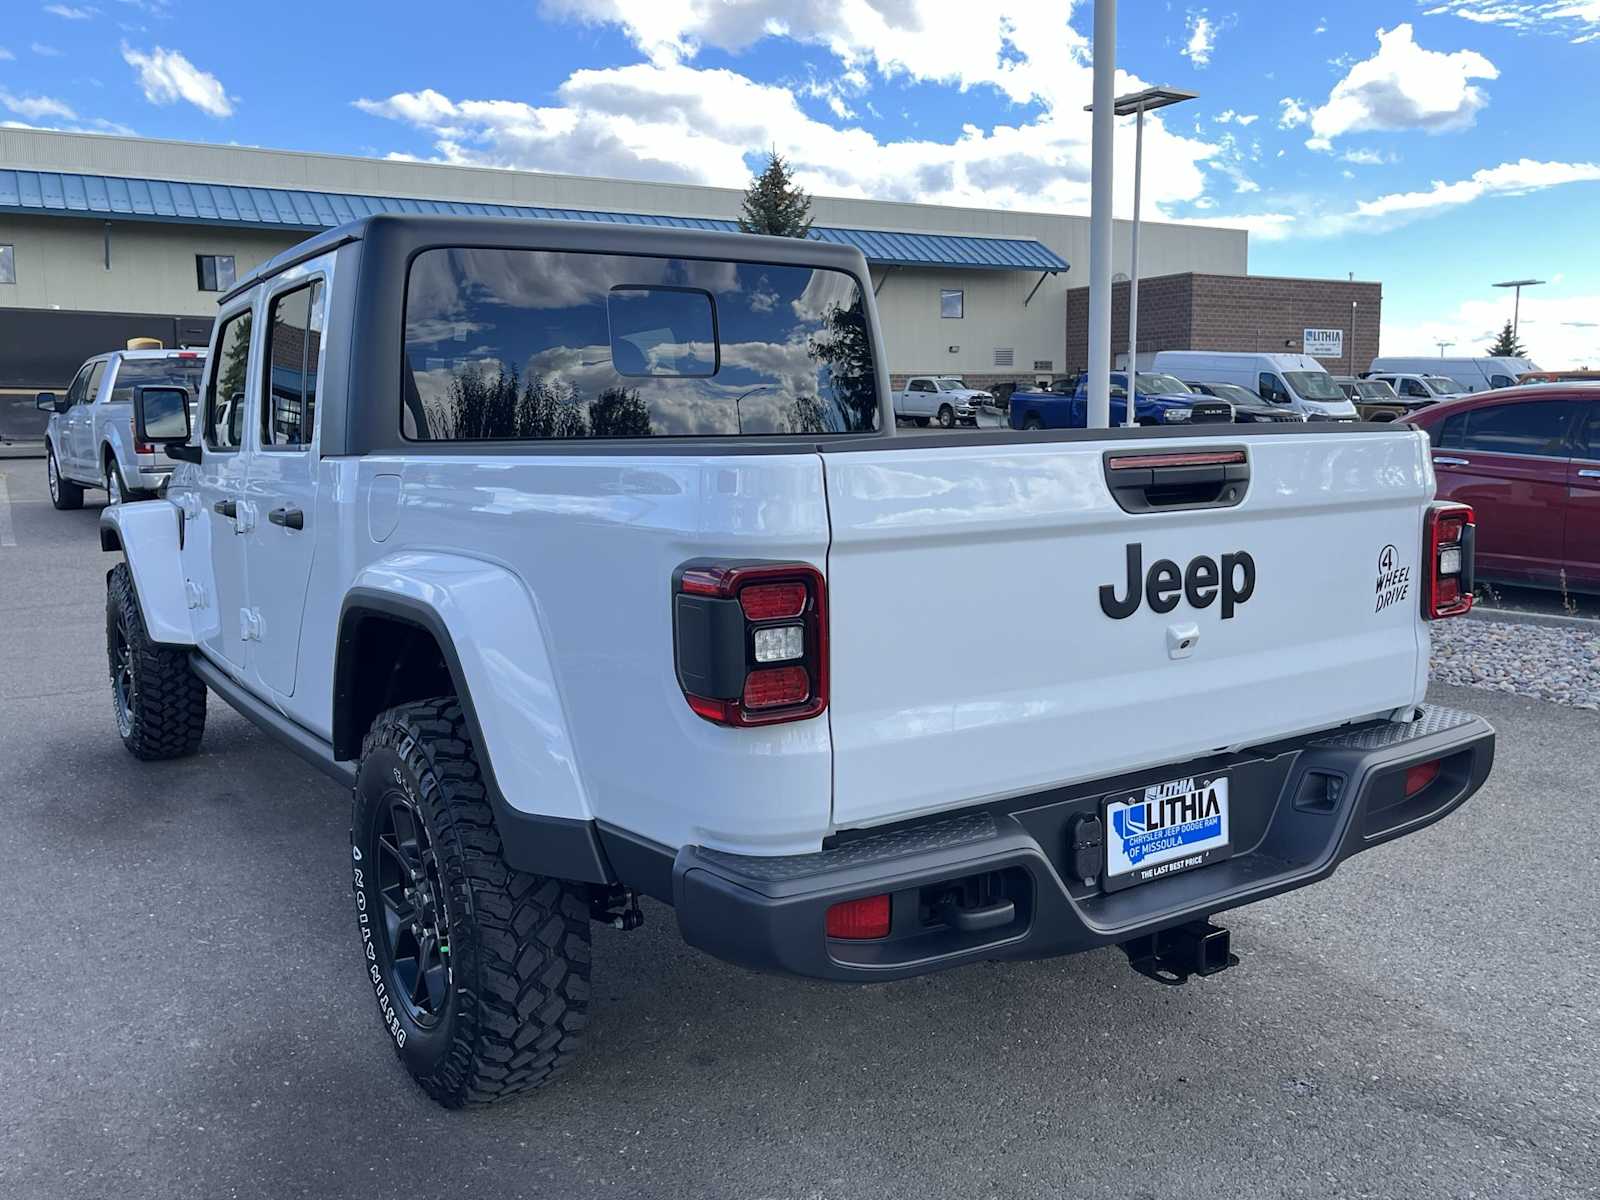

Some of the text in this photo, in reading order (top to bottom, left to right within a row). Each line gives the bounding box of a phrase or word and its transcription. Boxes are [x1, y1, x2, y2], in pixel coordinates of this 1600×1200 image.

[1313, 331, 1341, 342] LITHIA
[1098, 542, 1256, 620] Jeep
[1375, 566, 1410, 594] WHEEL
[1375, 584, 1409, 613] DRIVE
[1156, 778, 1196, 800] LITHIA
[1146, 788, 1220, 831] LITHIA
[1129, 817, 1218, 847] CHRYSLER JEEP DODGE RAM
[1129, 835, 1183, 858] OF MISSOULA
[1141, 855, 1203, 880] THE LAST BEST PRICE
[354, 868, 407, 1048] DESTINATION
